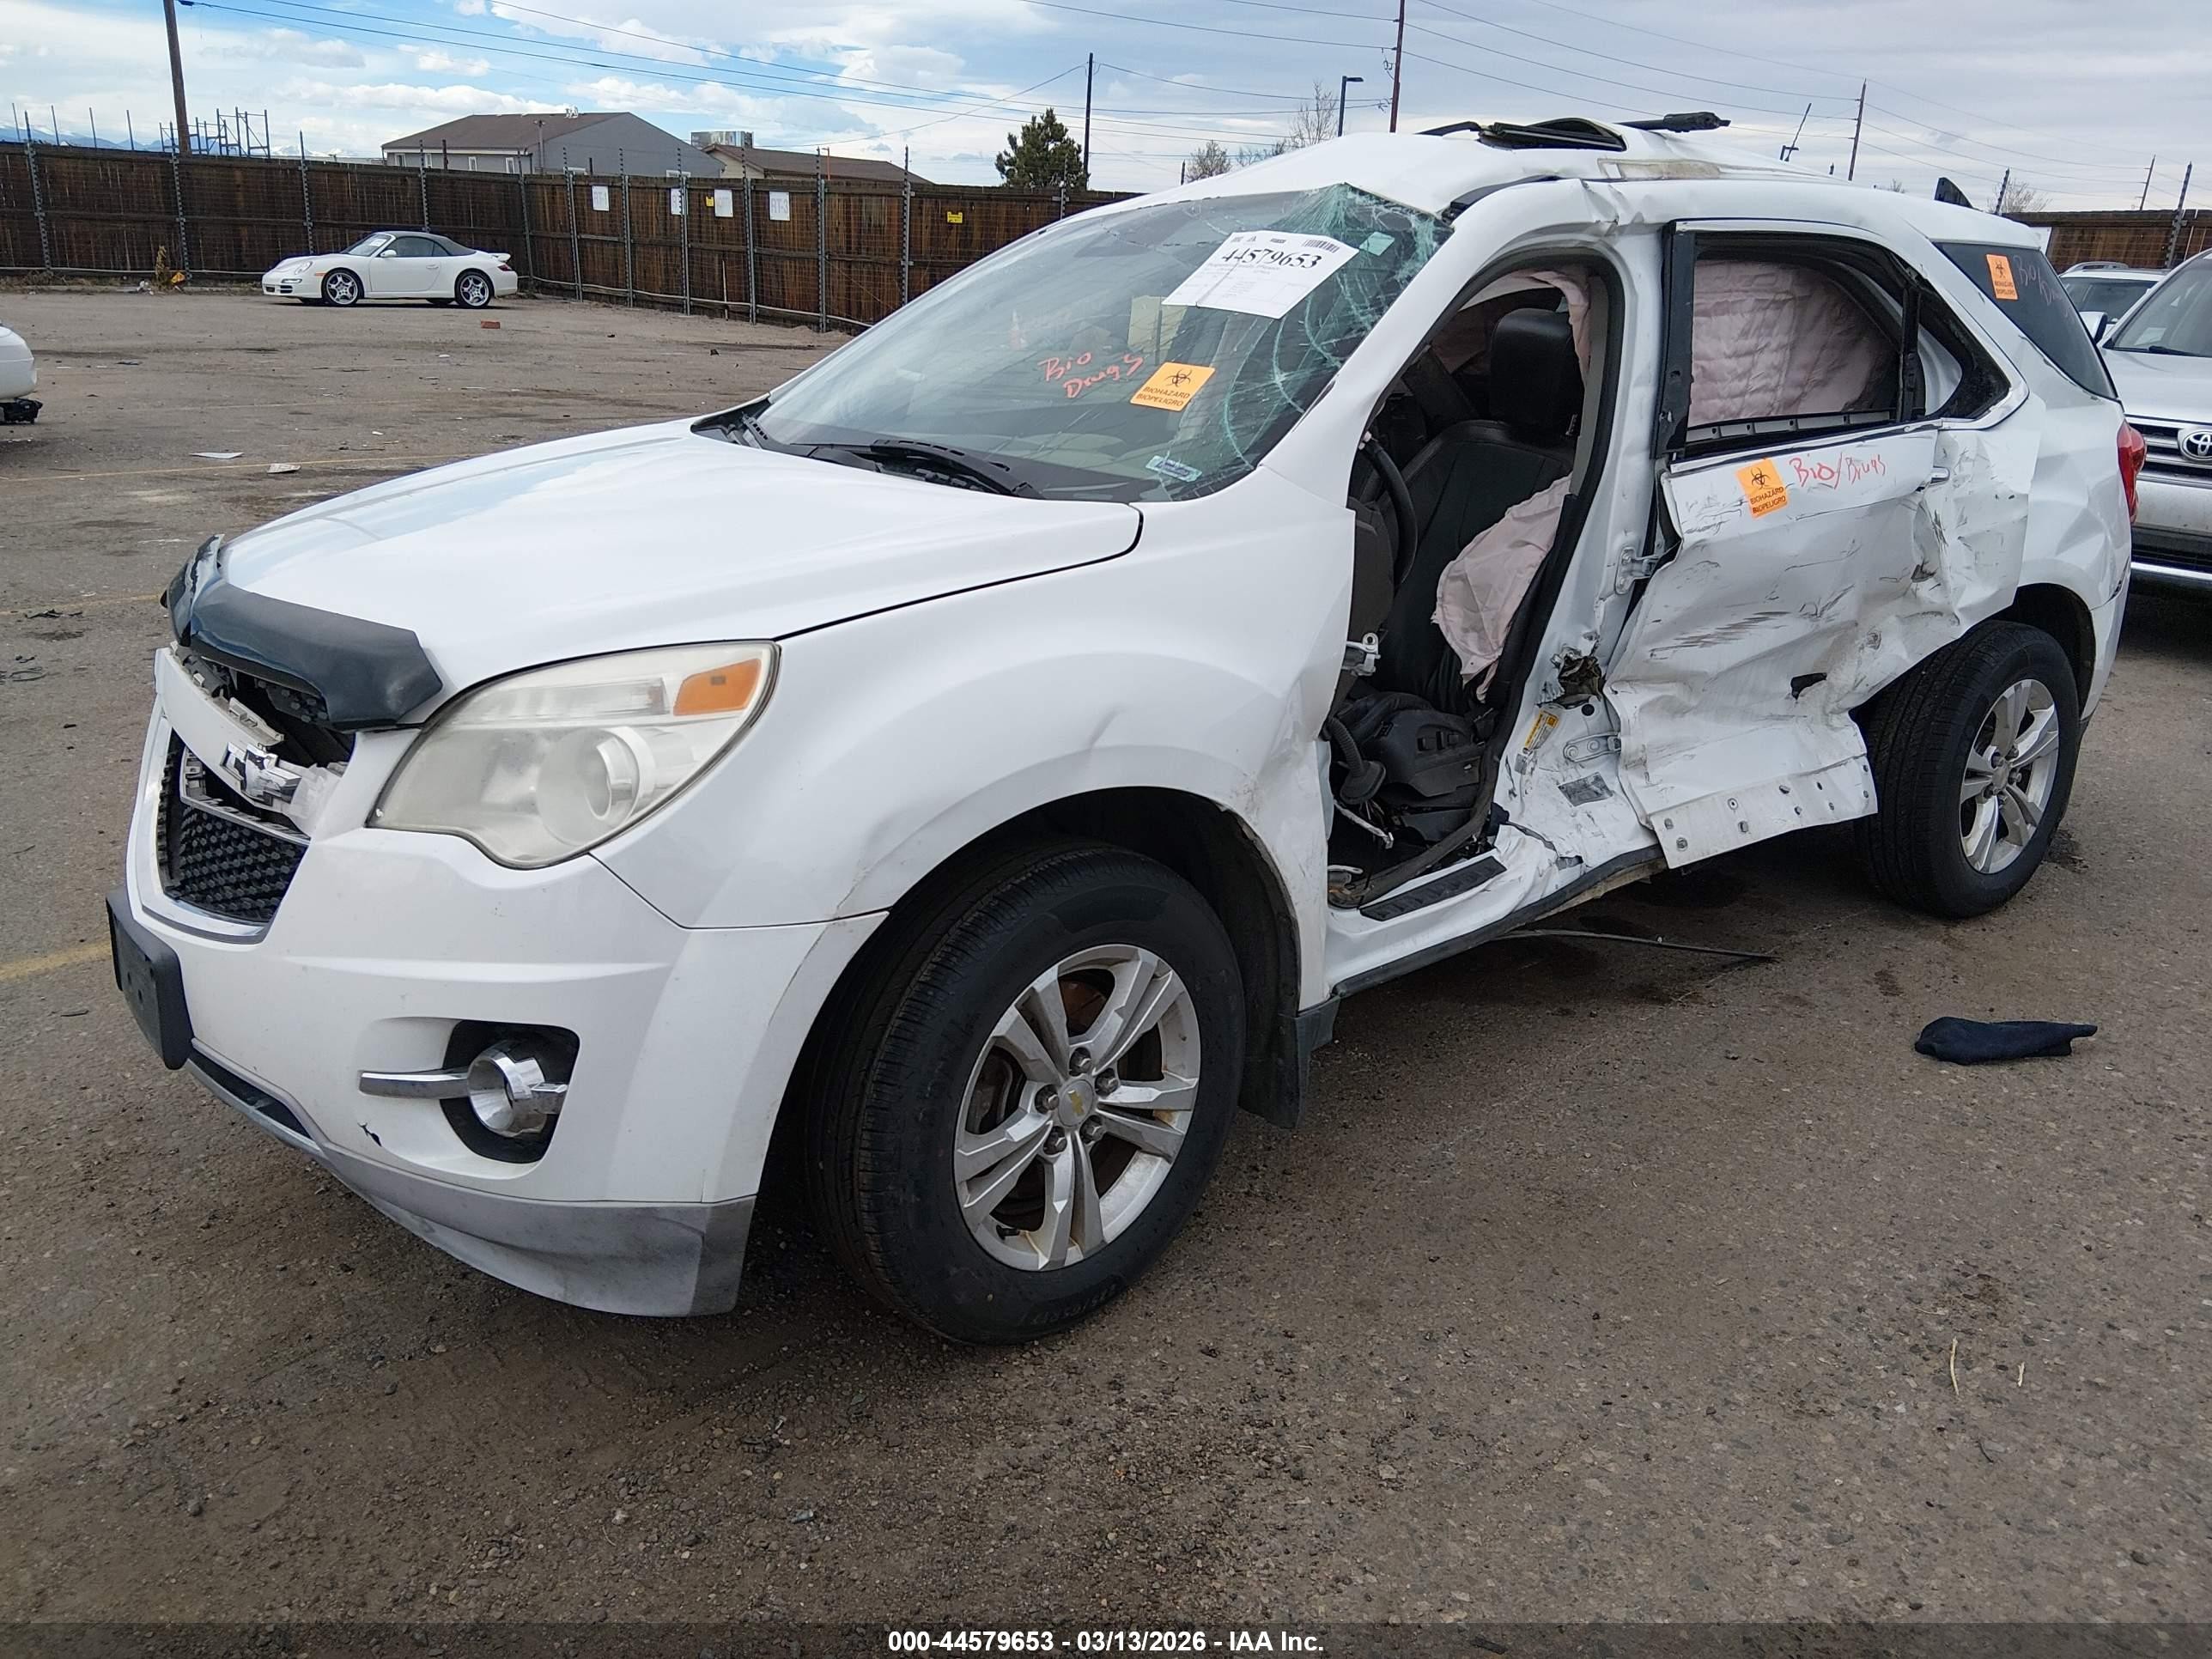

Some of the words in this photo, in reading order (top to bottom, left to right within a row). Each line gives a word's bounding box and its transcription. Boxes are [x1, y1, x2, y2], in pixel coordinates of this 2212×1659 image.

[1222, 247, 1322, 269] 44579653
[1037, 352, 1091, 382] Bio
[1136, 392, 1184, 408] BIOPELIGRO
[1143, 386, 1191, 400] BIOHAZARD
[1750, 486, 1784, 505] BIOHAZARD
[1752, 495, 1786, 515] BIOPELIGRO
